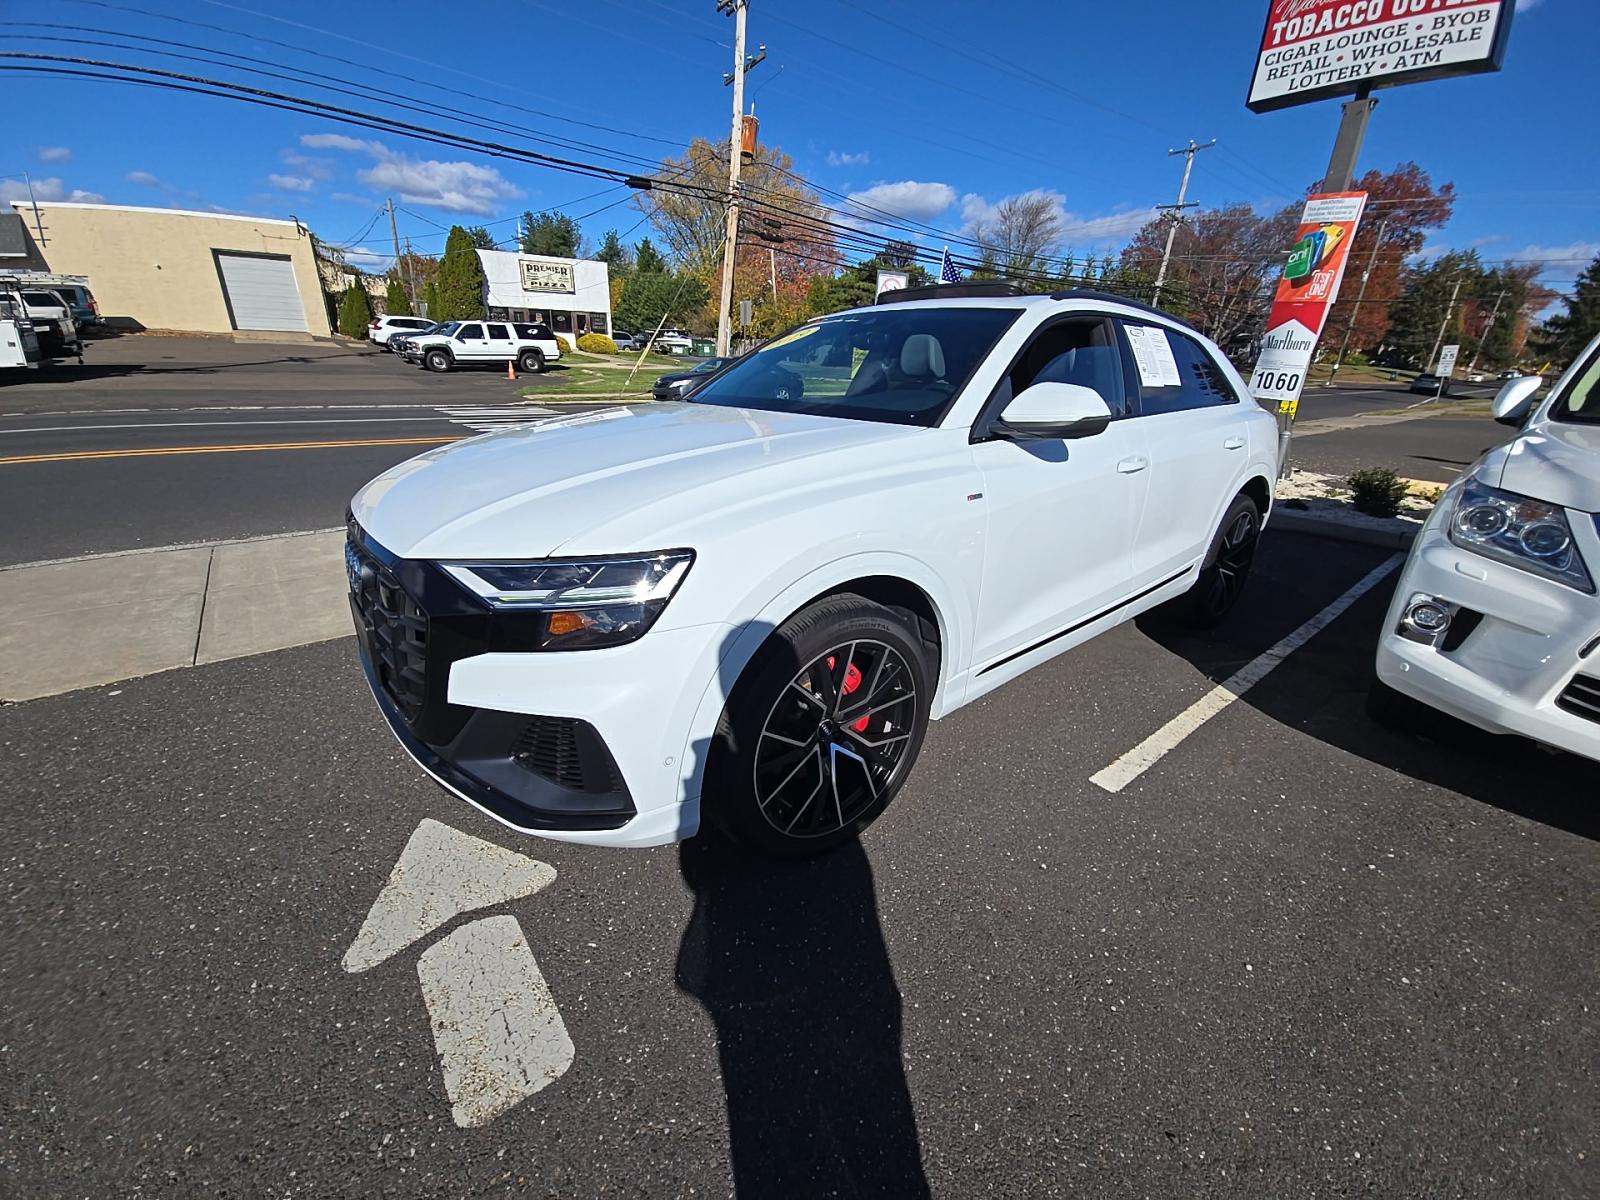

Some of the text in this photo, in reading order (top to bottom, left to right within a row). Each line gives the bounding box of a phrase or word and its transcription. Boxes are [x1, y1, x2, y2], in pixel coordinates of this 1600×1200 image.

[1264, 9, 1491, 66] CIGAR LOUNGE BYOB
[1272, 0, 1383, 45] TOBACCO
[1266, 27, 1482, 81] RETAIL WHOLESALE
[1288, 49, 1442, 91] LOTTERY ATM
[526, 264, 567, 275] PREMIER
[1267, 330, 1311, 351] Marlboro
